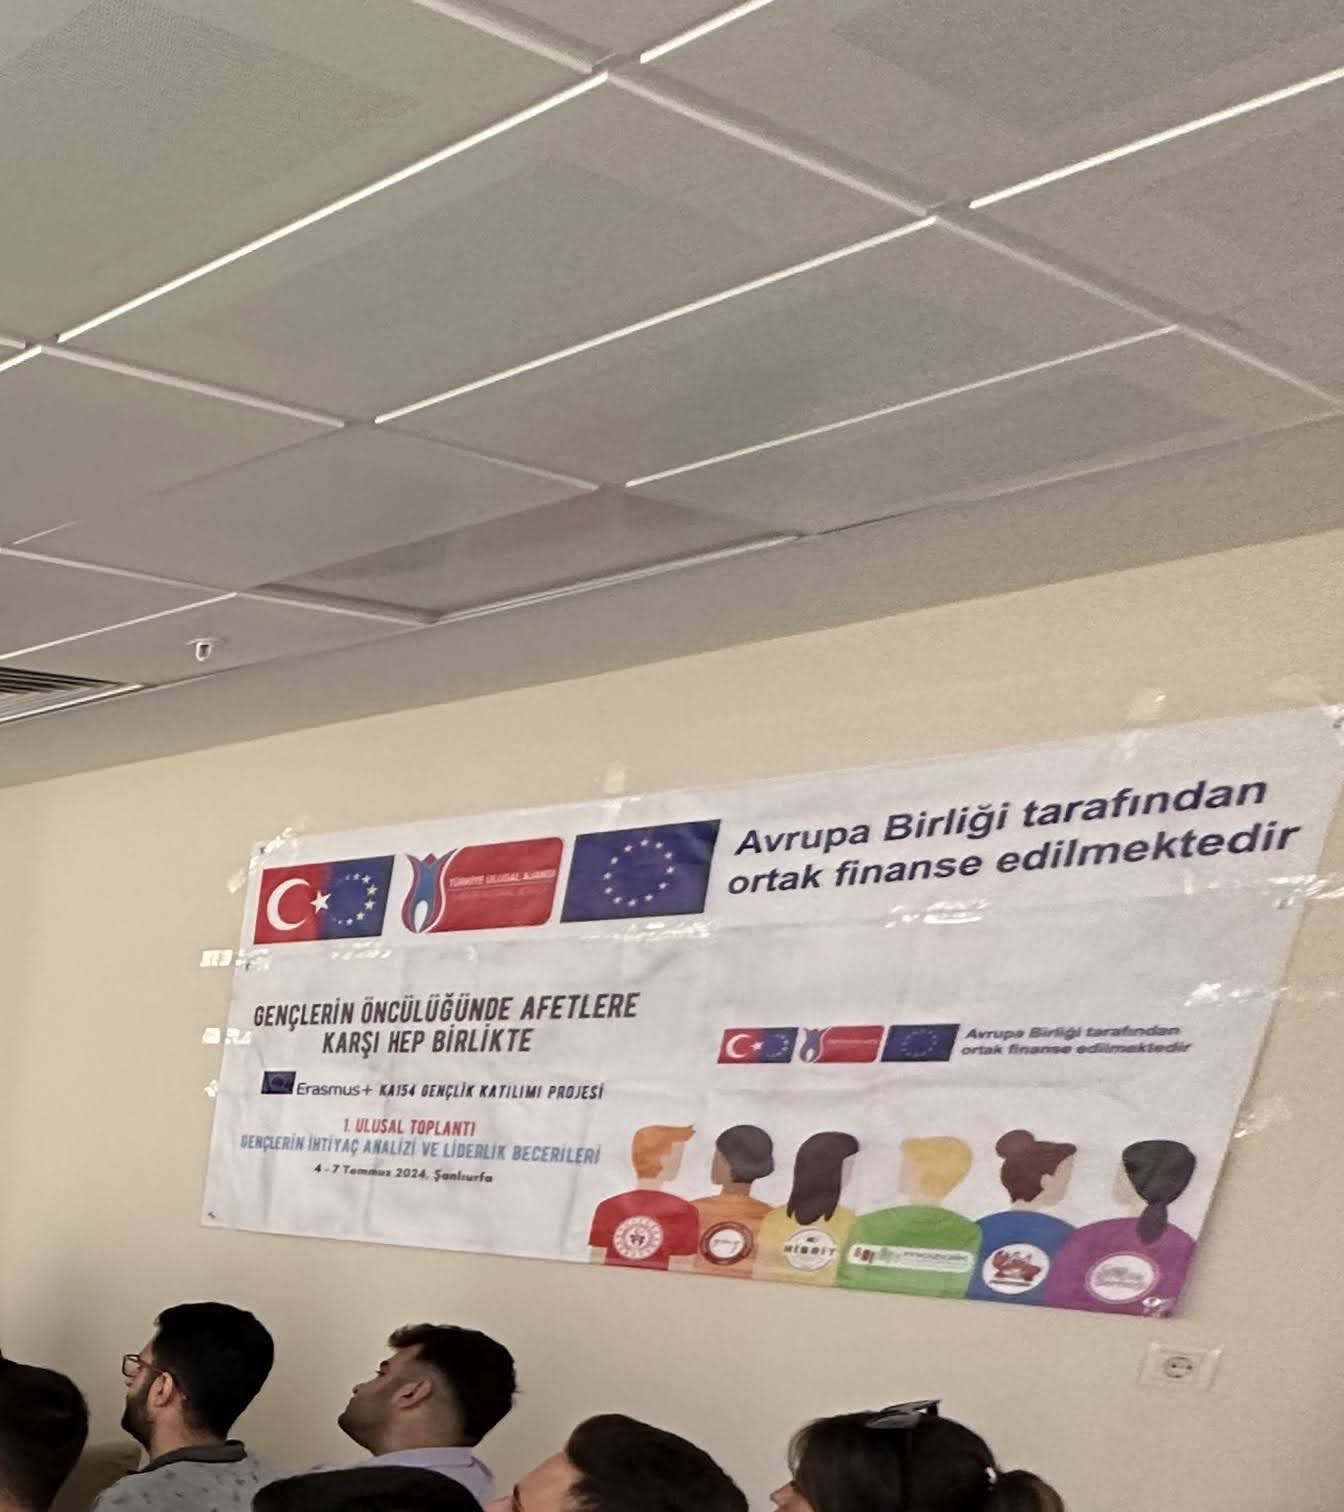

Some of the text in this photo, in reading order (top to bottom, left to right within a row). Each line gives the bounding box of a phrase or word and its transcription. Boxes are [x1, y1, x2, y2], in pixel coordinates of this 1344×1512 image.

[734, 779, 1268, 856] Avrupa Birliği tarafından
[727, 821, 1302, 895] ortak finanse edilmektedir
[254, 992, 640, 1031] GENÇLERİN ÖNCÜLÜĞÜNDE AFETLERE
[322, 1023, 535, 1059] KARŞI HEP BİRLİKTE
[965, 1028, 1024, 1041] Avrupa
[961, 1045, 1003, 1056] ortak
[1009, 1043, 1072, 1055] finanse
[296, 1083, 604, 1101] Erasmus+ KA154 GENÇLİK KATILIMI PROJESİ
[355, 1119, 404, 1135] ULUSAL
[410, 1119, 475, 1137] TOPLANTI
[240, 1134, 601, 1165] GENÇLERİN İHTİYAÇ ANALİZİ VE LİDERLİK BECERİLERİ
[343, 1165, 391, 1177] Temmuz
